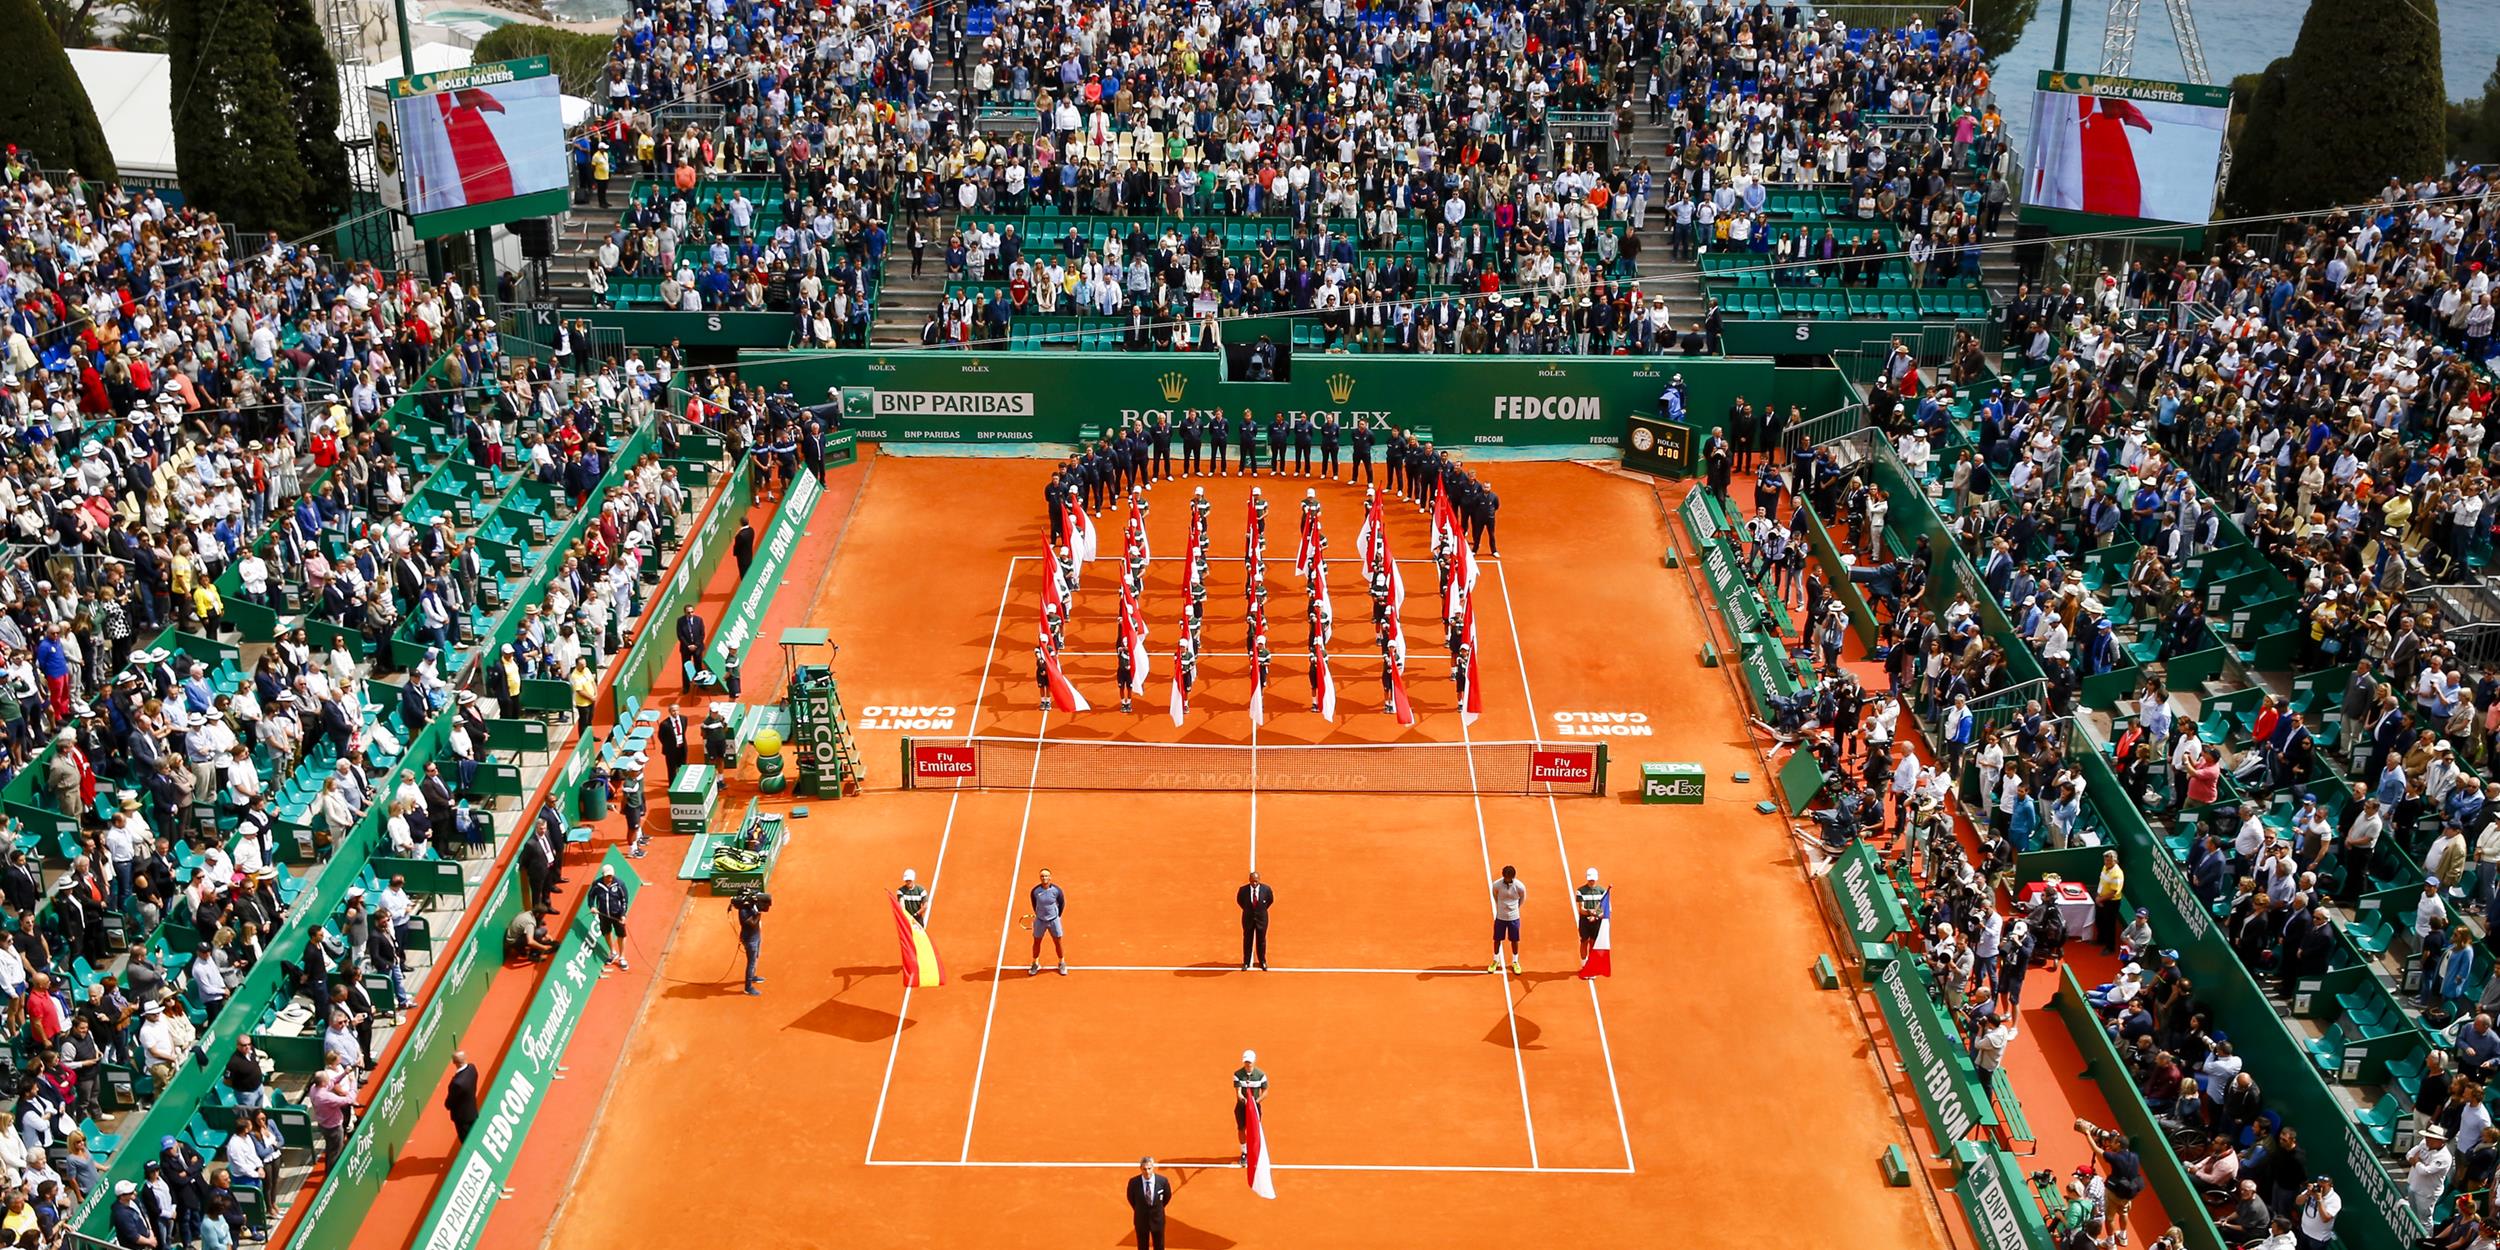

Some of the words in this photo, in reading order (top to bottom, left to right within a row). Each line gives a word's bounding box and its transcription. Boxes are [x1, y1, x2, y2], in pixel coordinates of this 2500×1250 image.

[436, 63, 506, 81] MONTE-CARLO
[436, 76, 469, 91] ROLEX
[471, 70, 514, 85] MASTERS
[2094, 76, 2178, 92] MONTE-CARLO
[2092, 84, 2129, 98] ROLEX
[2132, 88, 2184, 102] MASTERS
[120, 177, 152, 187] RANTS
[537, 311, 551, 325] K
[708, 317, 722, 331] S
[1795, 326, 1810, 341] S
[881, 394, 926, 412] BNP
[932, 395, 1024, 413] PARIBAS
[1494, 396, 1600, 420] FEDCOM
[825, 436, 852, 447] UGEOT
[855, 430, 888, 438] ARIBAS
[904, 430, 923, 438] BNP
[924, 431, 960, 439] PARIBAS
[977, 431, 996, 439] BNP
[997, 431, 1033, 439] PARIBAS
[1474, 435, 1503, 443] FEDCOM
[1589, 436, 1619, 444] FEDCOM
[1656, 438, 1680, 448] ROLEX
[1658, 446, 1679, 459] 0:00
[769, 519, 795, 563] FEDCOM
[1707, 545, 1732, 592] FEDCOM
[1756, 655, 1779, 697] PEUGEO
[862, 706, 956, 717] CARLO
[1554, 712, 1648, 723] CARLO
[859, 719, 954, 730] MONTE
[1559, 725, 1653, 736] MONTE
[810, 697, 837, 782] RICOH
[937, 752, 953, 761] Fly
[1554, 757, 1571, 768] Fly
[919, 761, 973, 772] Emirates
[1535, 765, 1588, 778] Emirates
[1142, 774, 1190, 787] ATP
[1198, 774, 1292, 788] WORLD
[1300, 774, 1368, 789] TOUR
[1646, 779, 1703, 796] FedEx
[1842, 857, 1880, 933] Malongo
[2152, 844, 2194, 912] MONTE-CARLO
[2194, 909, 2208, 932] BAY
[2152, 861, 2171, 896] HOTEL
[2177, 898, 2203, 941] RESORT
[575, 913, 602, 969] PEUG
[521, 980, 573, 1074] Façonnable
[1890, 976, 1912, 1017] SERGIO
[1906, 1011, 1934, 1067] TACCHINI
[1924, 1058, 1970, 1145] FEDCOM
[481, 1069, 535, 1163] FEDCOM
[2343, 1126, 2384, 1193] THERMES
[2386, 1188, 2421, 1240] MARIN
[72, 1203, 91, 1231] NDIAN
[90, 1177, 109, 1209] WELLS
[314, 1176, 339, 1222] TACCHINI
[445, 1162, 485, 1232] PARIBAS
[1984, 1186, 2008, 1221] BNP
[2347, 1151, 2411, 1250] MONTE-CARLO
